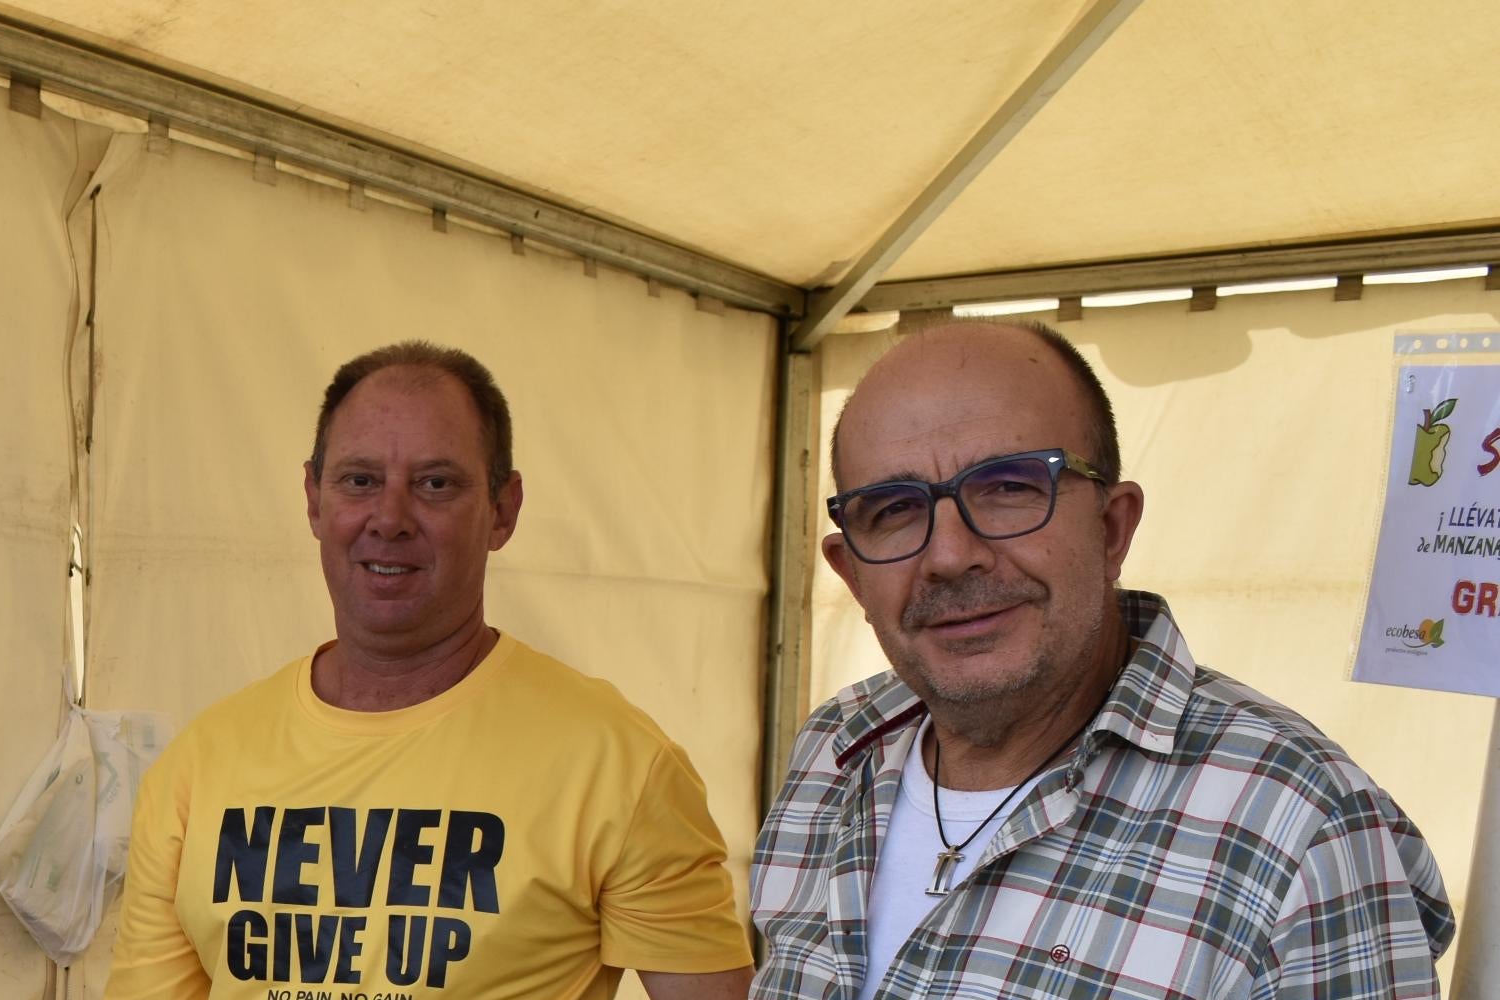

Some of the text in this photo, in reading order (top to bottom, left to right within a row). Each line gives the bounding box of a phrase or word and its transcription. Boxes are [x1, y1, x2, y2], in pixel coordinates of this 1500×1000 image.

[1417, 535, 1500, 559] de MANZANA
[1452, 579, 1500, 617] GR
[1386, 624, 1426, 640] ecobesa
[213, 806, 505, 914] NEVER
[227, 910, 471, 988] GIVE UP
